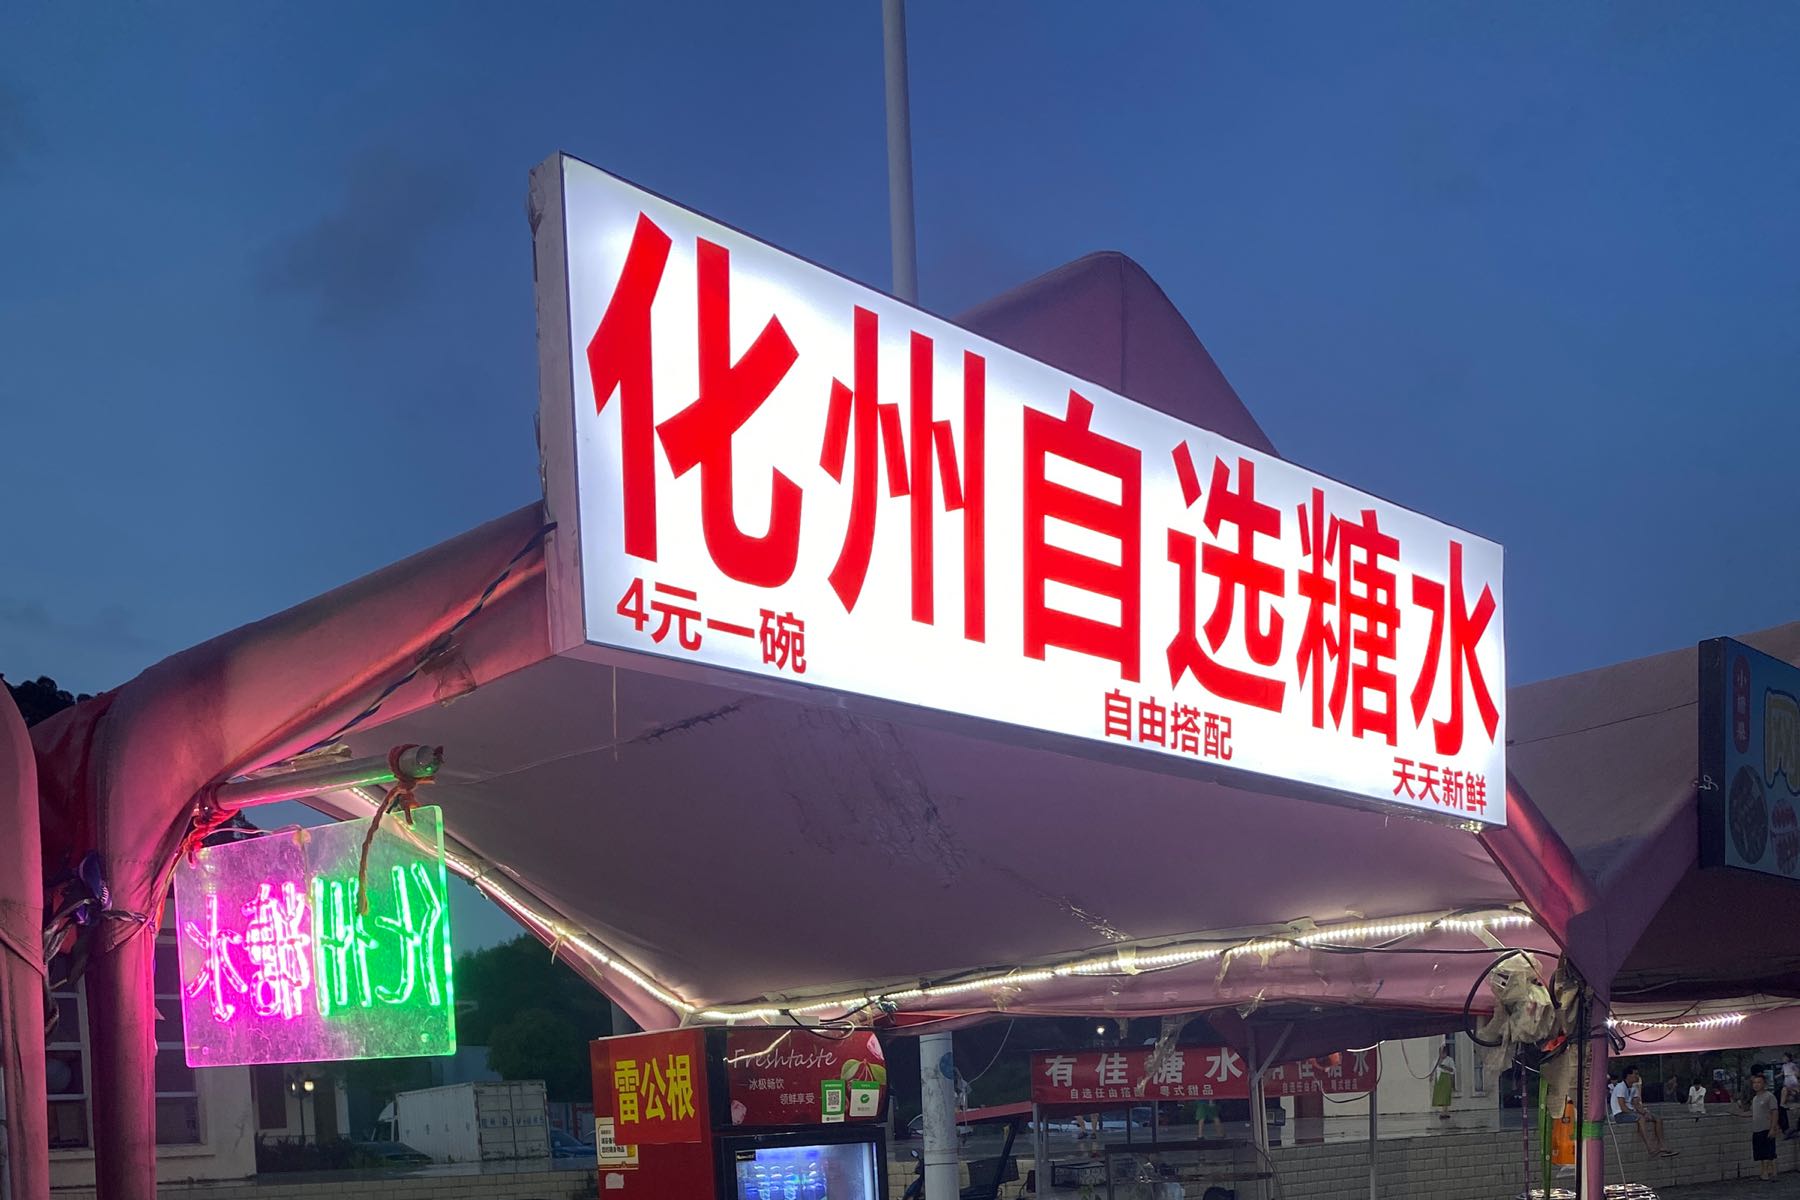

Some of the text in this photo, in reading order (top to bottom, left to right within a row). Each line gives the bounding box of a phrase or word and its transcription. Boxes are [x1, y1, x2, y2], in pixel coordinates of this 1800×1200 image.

[586, 211, 1499, 756] 化州自选糖水
[616, 577, 806, 674] 4元一碗
[1104, 689, 1232, 761] 自由搭配
[1393, 757, 1486, 816] 天天新鲜
[614, 1055, 694, 1125] 雷公根
[733, 1048, 839, 1070] Freshtaste
[1045, 1047, 1243, 1087] 有佳糖水
